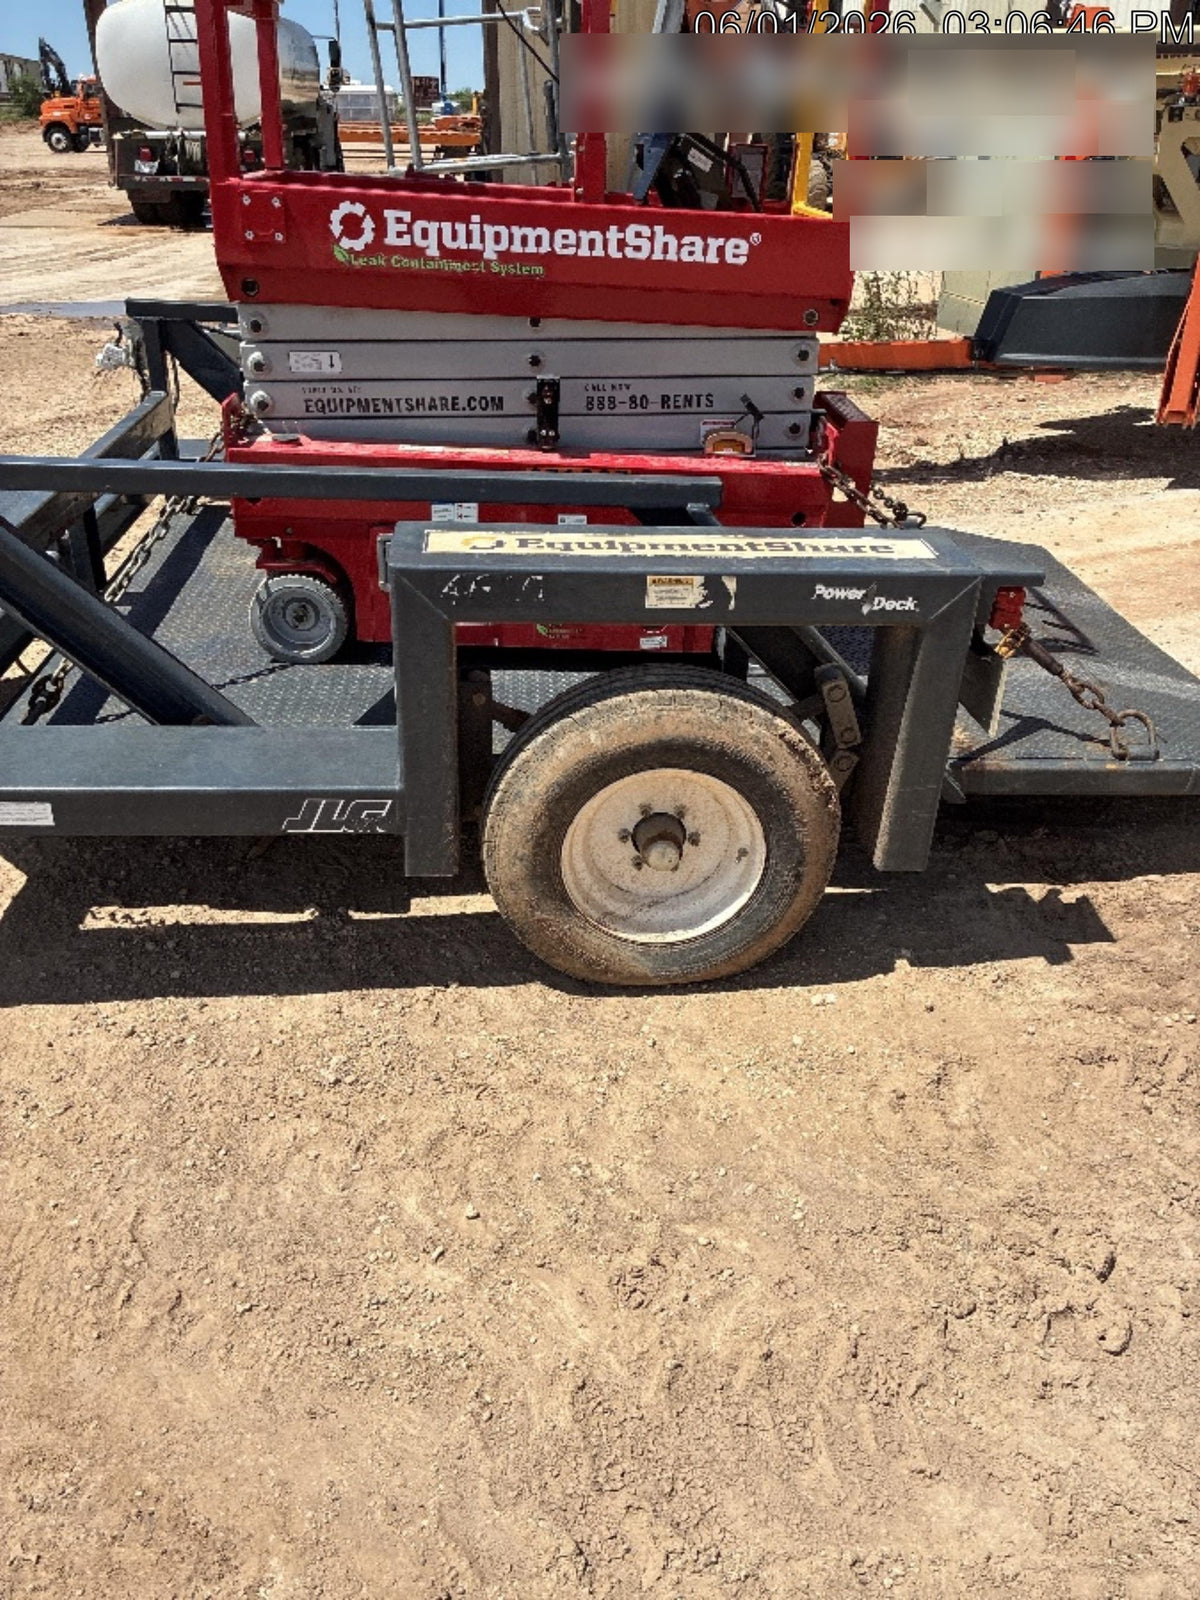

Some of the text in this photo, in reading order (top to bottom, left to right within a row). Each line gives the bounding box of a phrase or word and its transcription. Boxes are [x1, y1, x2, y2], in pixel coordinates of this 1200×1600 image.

[350, 252, 386, 268] Leak
[490, 260, 545, 278] System
[304, 396, 504, 415] EQUIPMENTSHARE.COM
[515, 537, 896, 554] EquipmentShare
[811, 583, 918, 612] Power Deck
[281, 798, 393, 833] JLG
